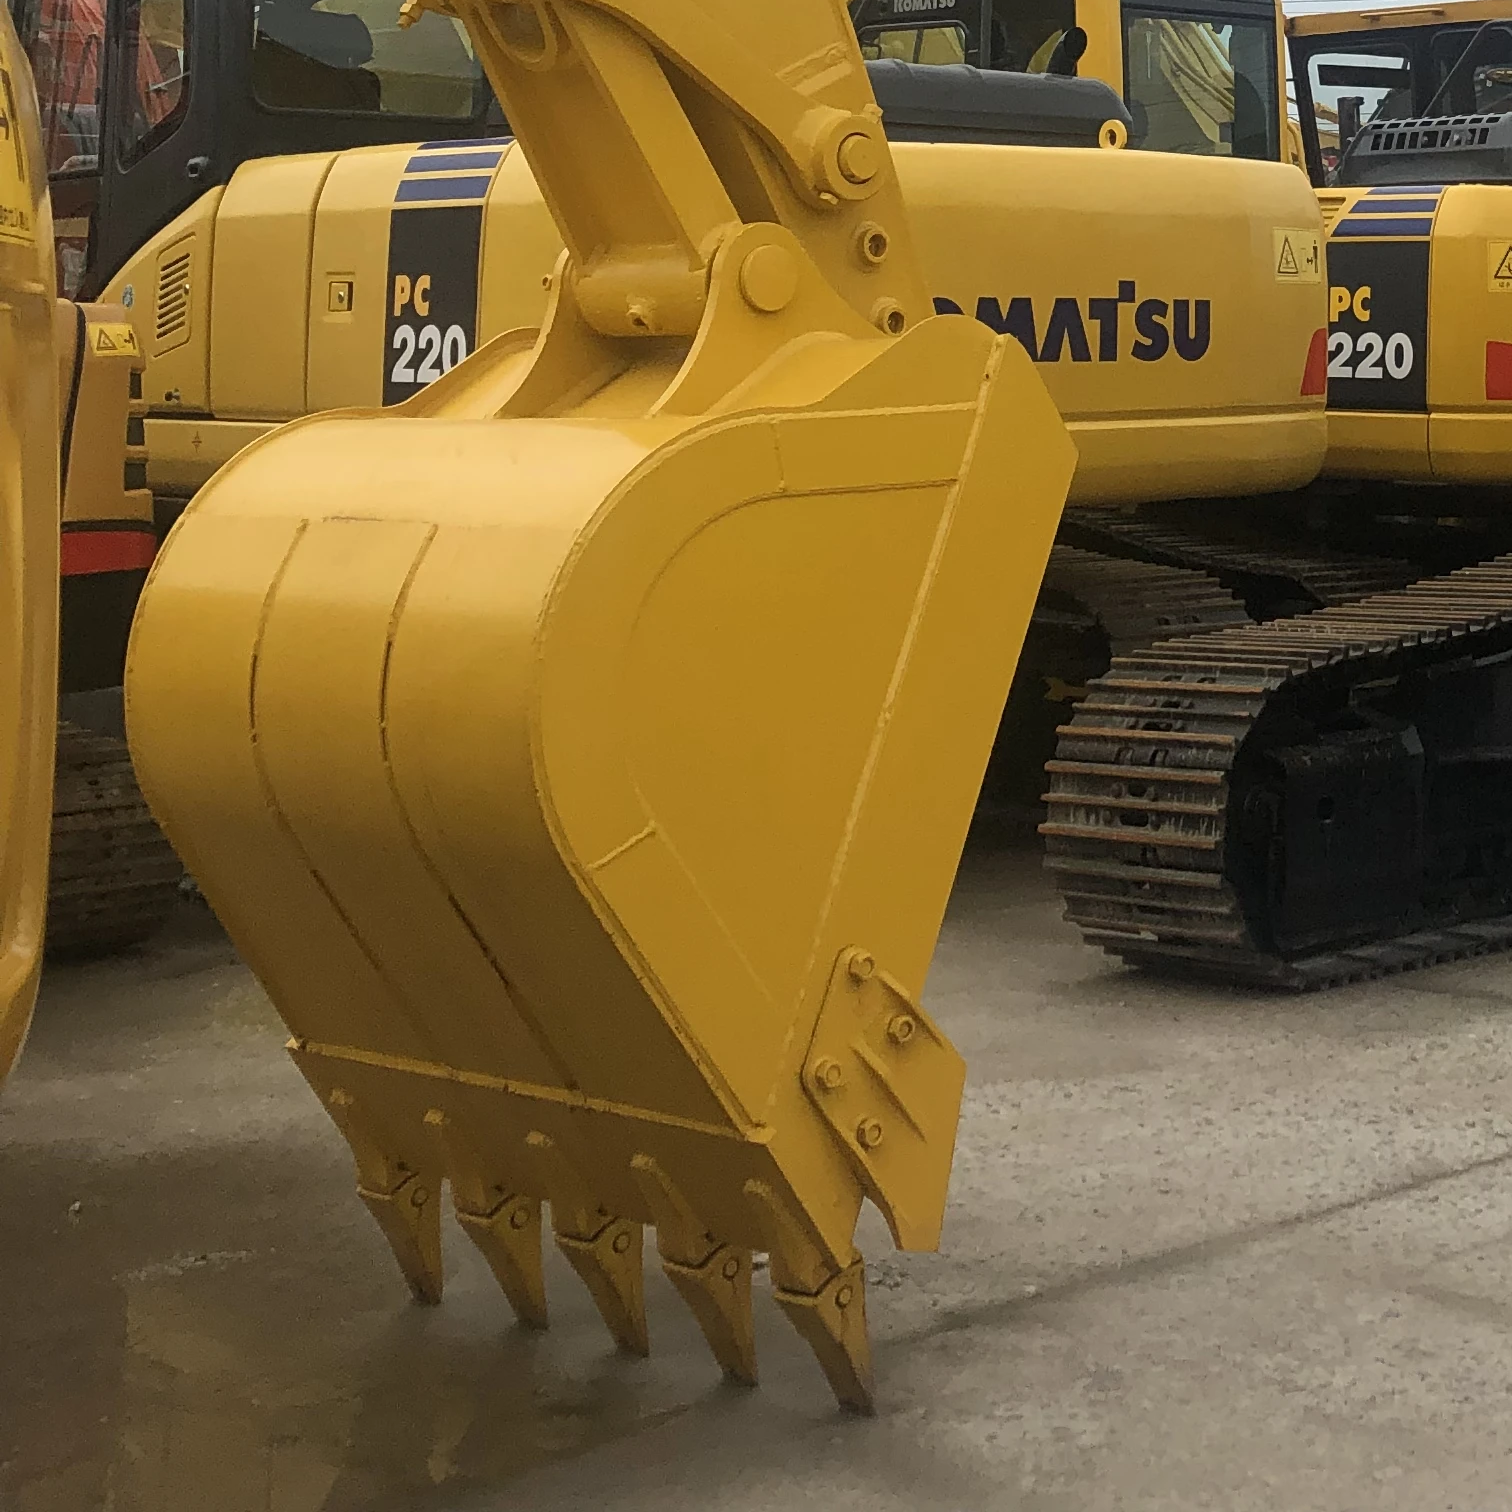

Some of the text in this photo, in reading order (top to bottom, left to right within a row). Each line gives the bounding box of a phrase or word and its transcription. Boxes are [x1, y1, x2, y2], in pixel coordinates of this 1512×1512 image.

[394, 274, 431, 317] PC
[1329, 286, 1371, 322] PC
[391, 324, 467, 383] 220
[1327, 331, 1414, 380] 220
